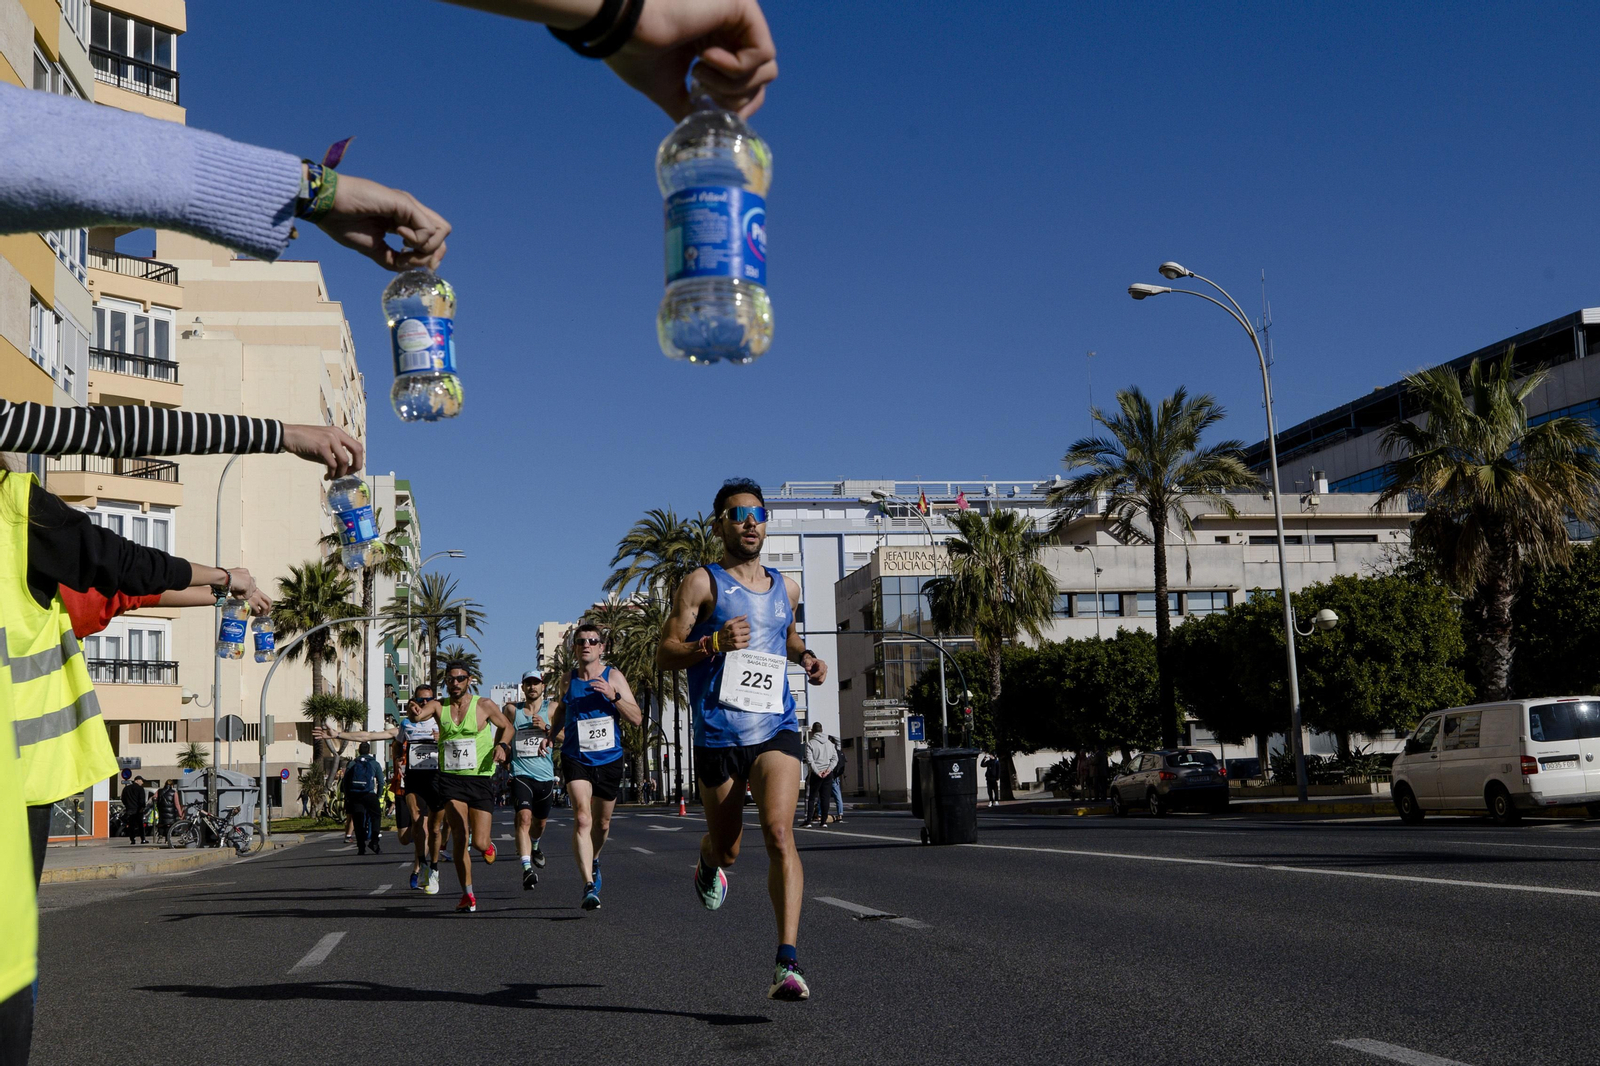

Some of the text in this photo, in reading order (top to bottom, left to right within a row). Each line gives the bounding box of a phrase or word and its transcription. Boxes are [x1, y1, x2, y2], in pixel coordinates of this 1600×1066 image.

[884, 551, 927, 560] JEFATURA
[884, 561, 920, 570] POLICIA
[740, 670, 772, 690] 225
[911, 722, 921, 732] P
[589, 728, 607, 739] 238
[453, 749, 468, 758] 574
